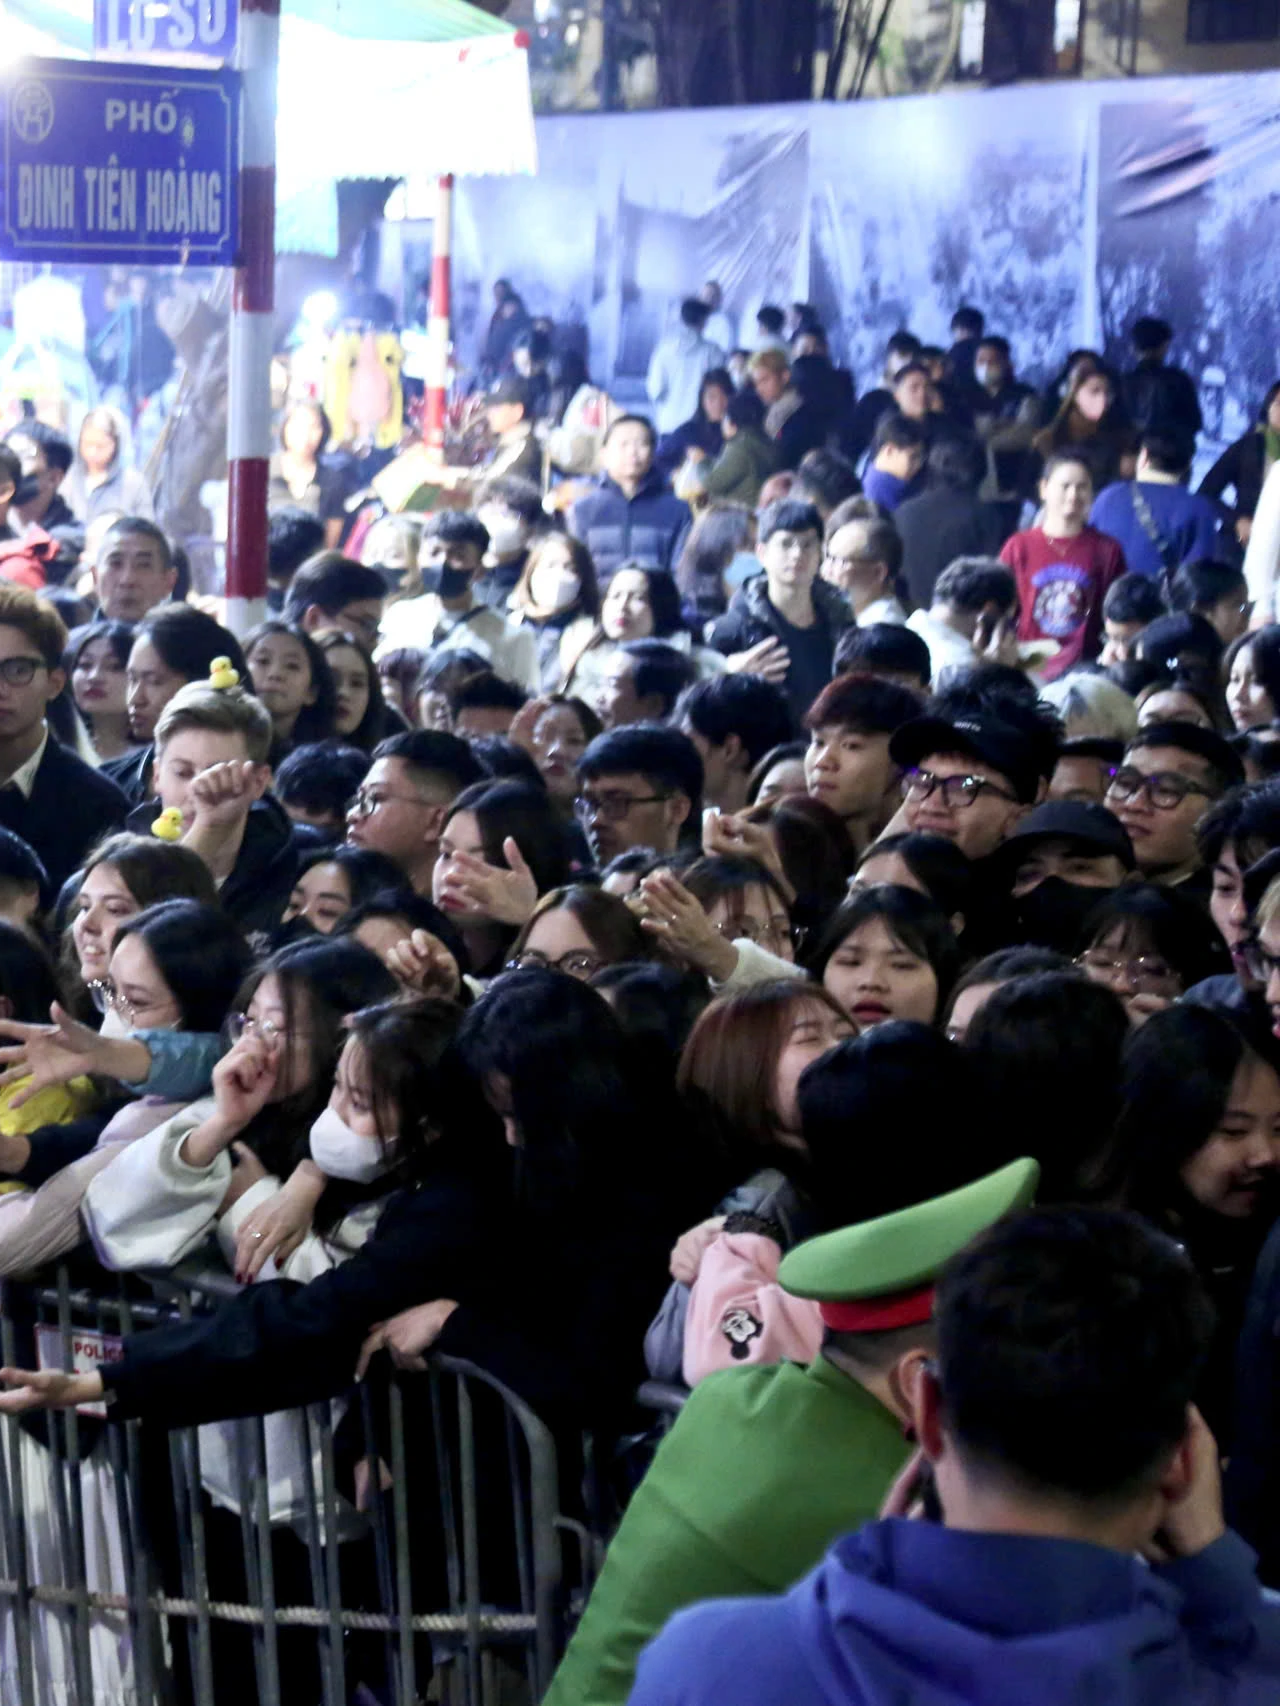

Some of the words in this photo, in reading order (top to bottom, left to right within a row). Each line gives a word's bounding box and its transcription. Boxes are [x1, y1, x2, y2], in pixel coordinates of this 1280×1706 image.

[105, 87, 180, 134] PHỐ
[83, 153, 137, 232] TIÊN
[146, 155, 222, 234] HOÀNG
